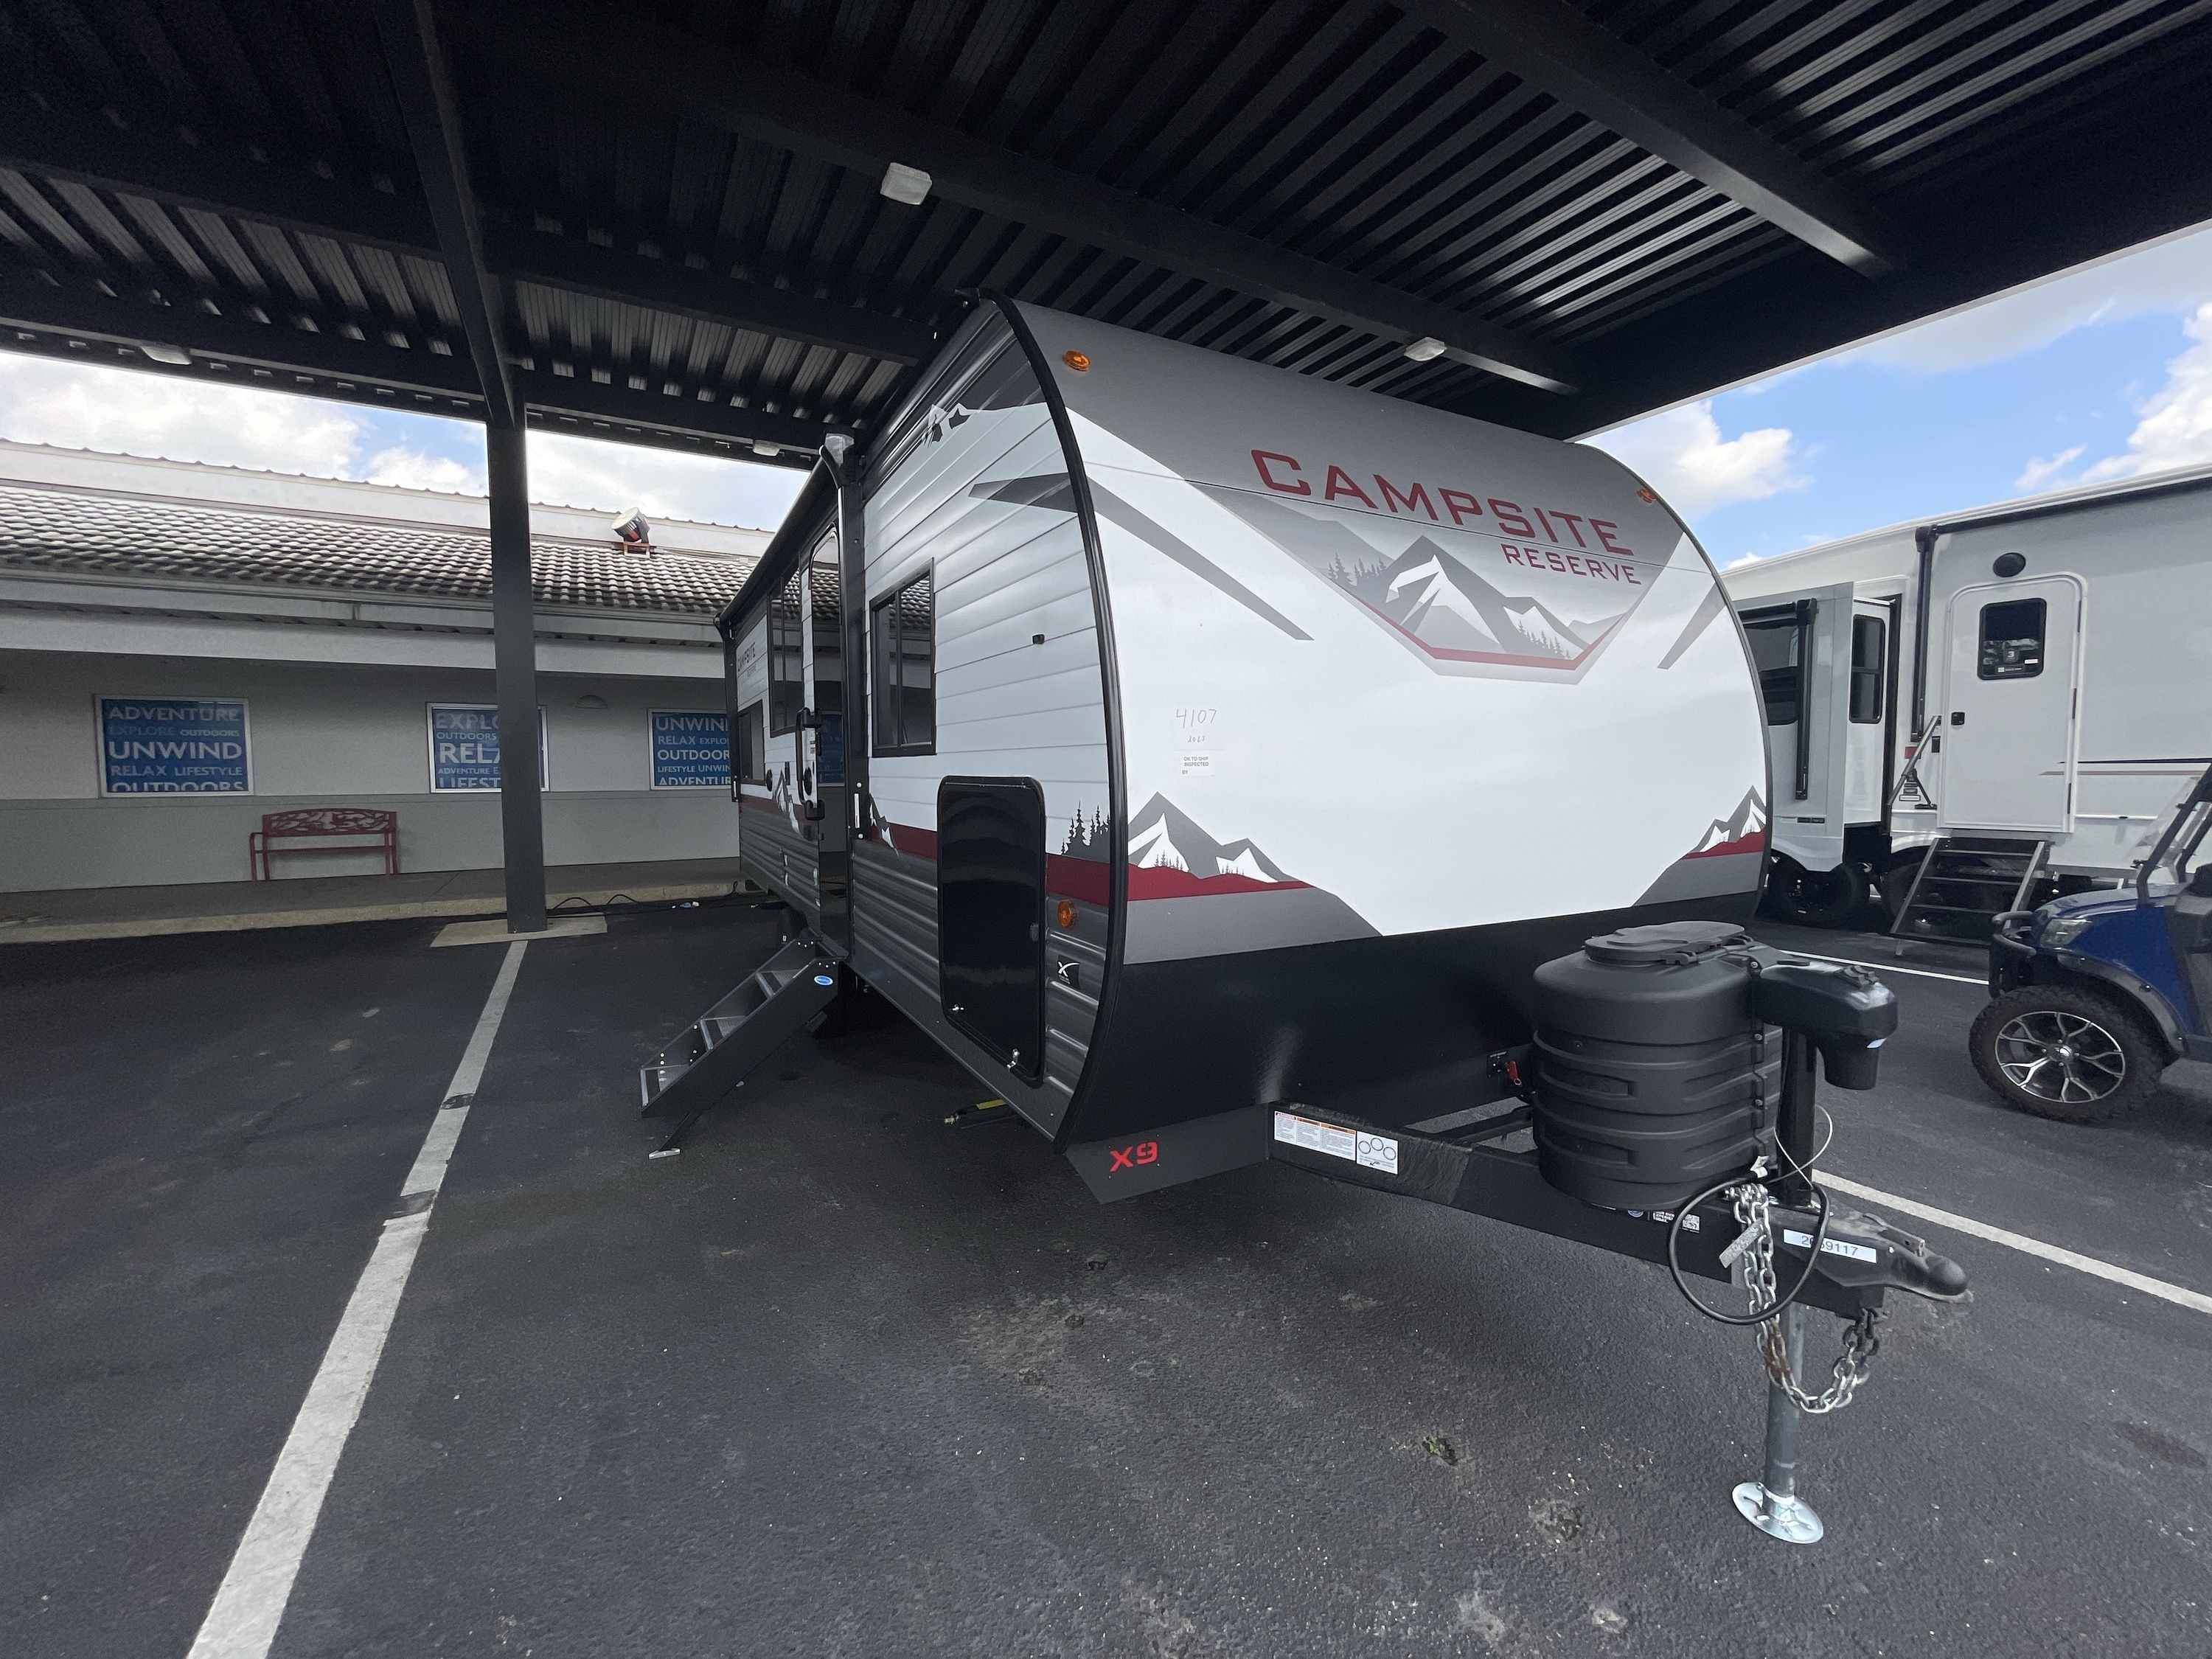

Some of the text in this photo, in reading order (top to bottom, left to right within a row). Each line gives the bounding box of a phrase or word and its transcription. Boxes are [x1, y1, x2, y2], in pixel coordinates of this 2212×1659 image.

[1251, 449, 1634, 556] CAMPSITE
[1500, 543, 1642, 585] RESERVE
[109, 706, 240, 722] ADVENTURE
[1176, 709, 1217, 728] 4107
[108, 725, 175, 737] EXPLORE
[655, 717, 728, 731] UNWIN
[436, 731, 497, 740] OUTDOORS
[658, 736, 696, 745] RELAX
[108, 741, 242, 759] UNWIND
[111, 765, 243, 776] RELAX LIFESTYLE
[112, 782, 244, 792] OUTDOORS
[1110, 1141, 1158, 1172] X9
[1801, 1235, 1859, 1256] 29117
